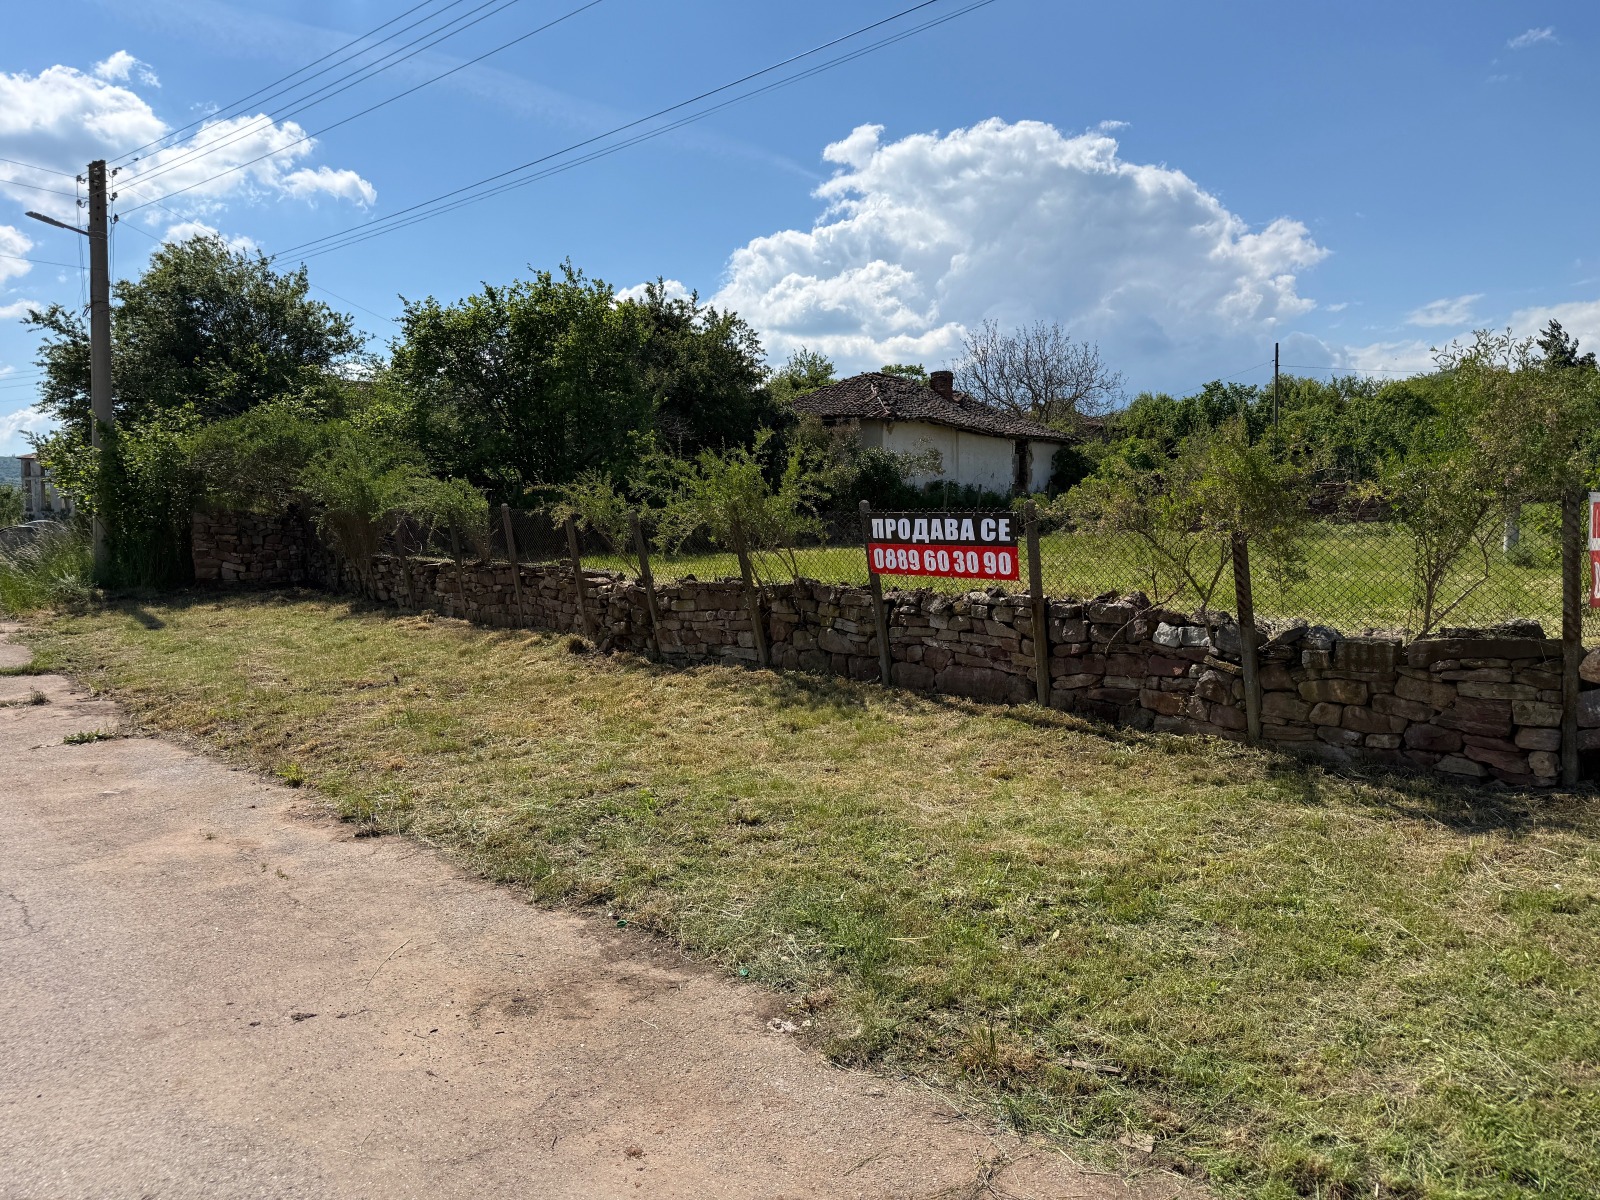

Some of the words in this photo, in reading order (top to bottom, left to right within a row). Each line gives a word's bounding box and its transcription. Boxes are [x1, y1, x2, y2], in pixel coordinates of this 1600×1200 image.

[871, 518, 975, 543] ПРОДАВА
[981, 518, 1011, 542] СЕ
[873, 548, 920, 571] 0889
[923, 550, 950, 572] 60
[953, 550, 979, 574] 30
[983, 551, 1012, 575] 90
